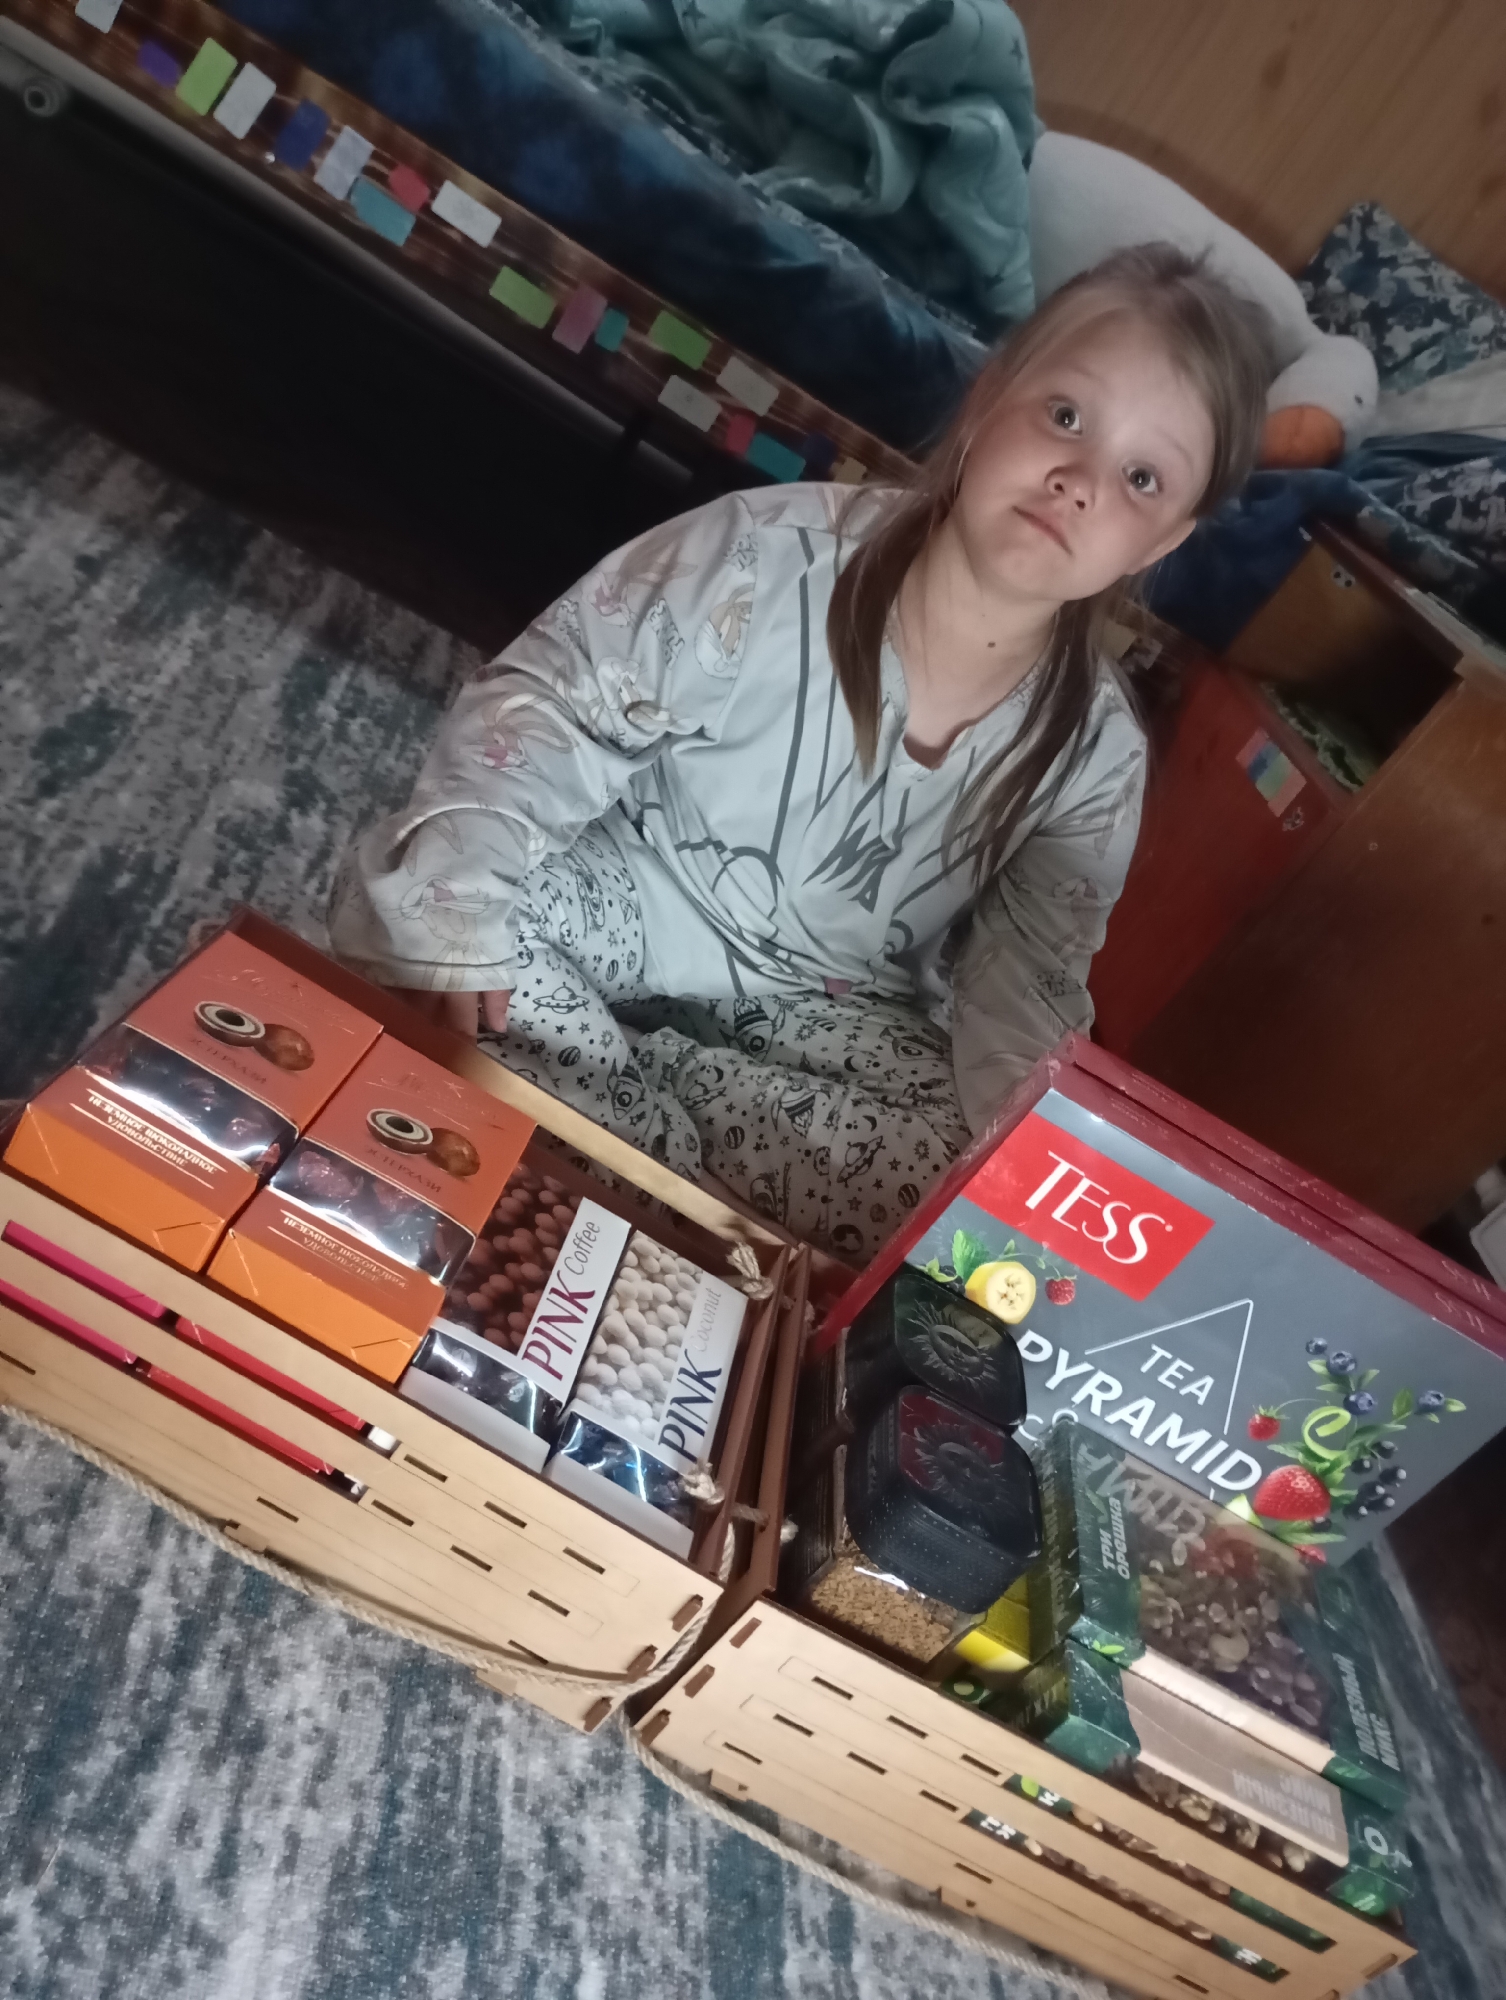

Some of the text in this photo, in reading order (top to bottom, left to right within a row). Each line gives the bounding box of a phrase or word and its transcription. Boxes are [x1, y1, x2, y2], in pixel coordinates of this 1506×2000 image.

[1024, 1149, 1168, 1265] TESS
[522, 1220, 601, 1382] PINK Coffee
[658, 1287, 723, 1464] PINK Coconut
[1140, 1343, 1216, 1406] TEA
[1331, 1652, 1380, 1760] ПОЛЕЗНЫЙ
[1370, 1712, 1401, 1771] МИКС
